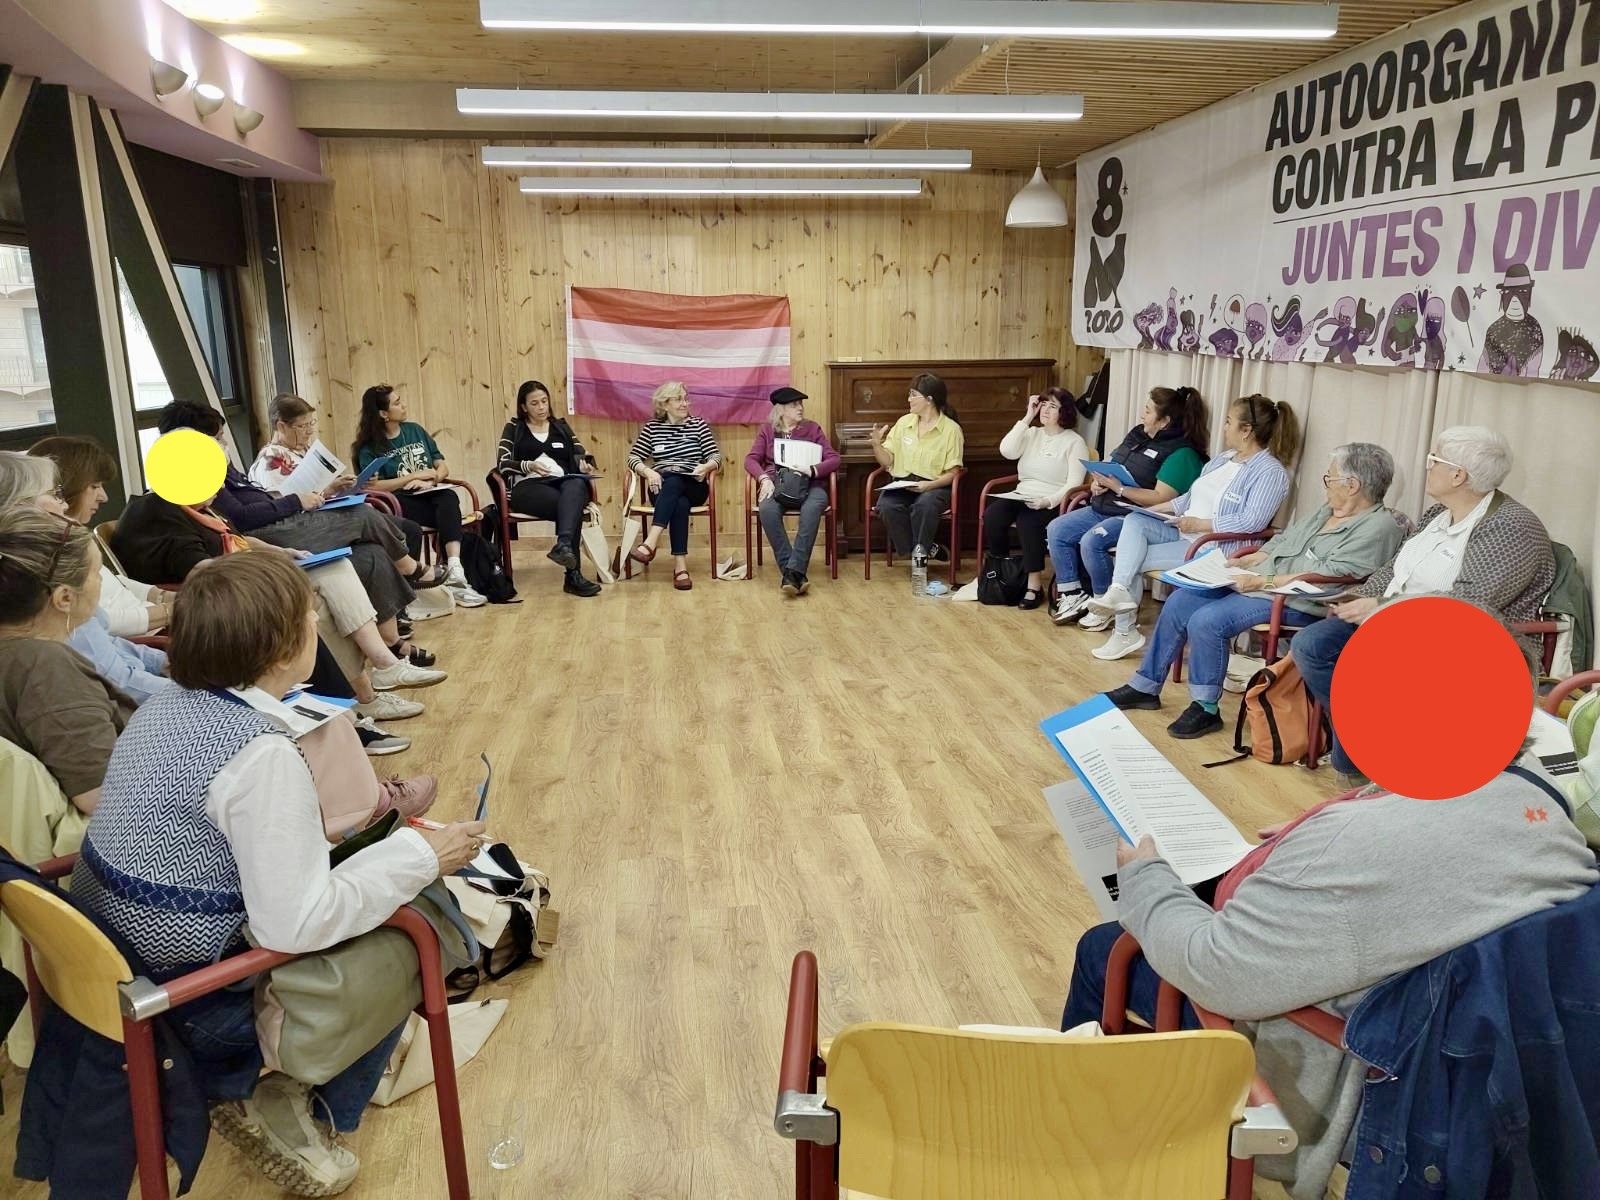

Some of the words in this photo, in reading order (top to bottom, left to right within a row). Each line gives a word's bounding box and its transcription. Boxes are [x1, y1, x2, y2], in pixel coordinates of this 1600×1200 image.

[1273, 117, 1436, 213] CONTRA
[1453, 97, 1525, 181] LA
[1545, 81, 1600, 168] P
[1092, 157, 1123, 238] 8
[1282, 206, 1443, 285] JUNTES
[1457, 202, 1476, 274] I
[1493, 186, 1600, 273] DIV
[1084, 233, 1127, 308] M
[1085, 309, 1124, 333] 2020
